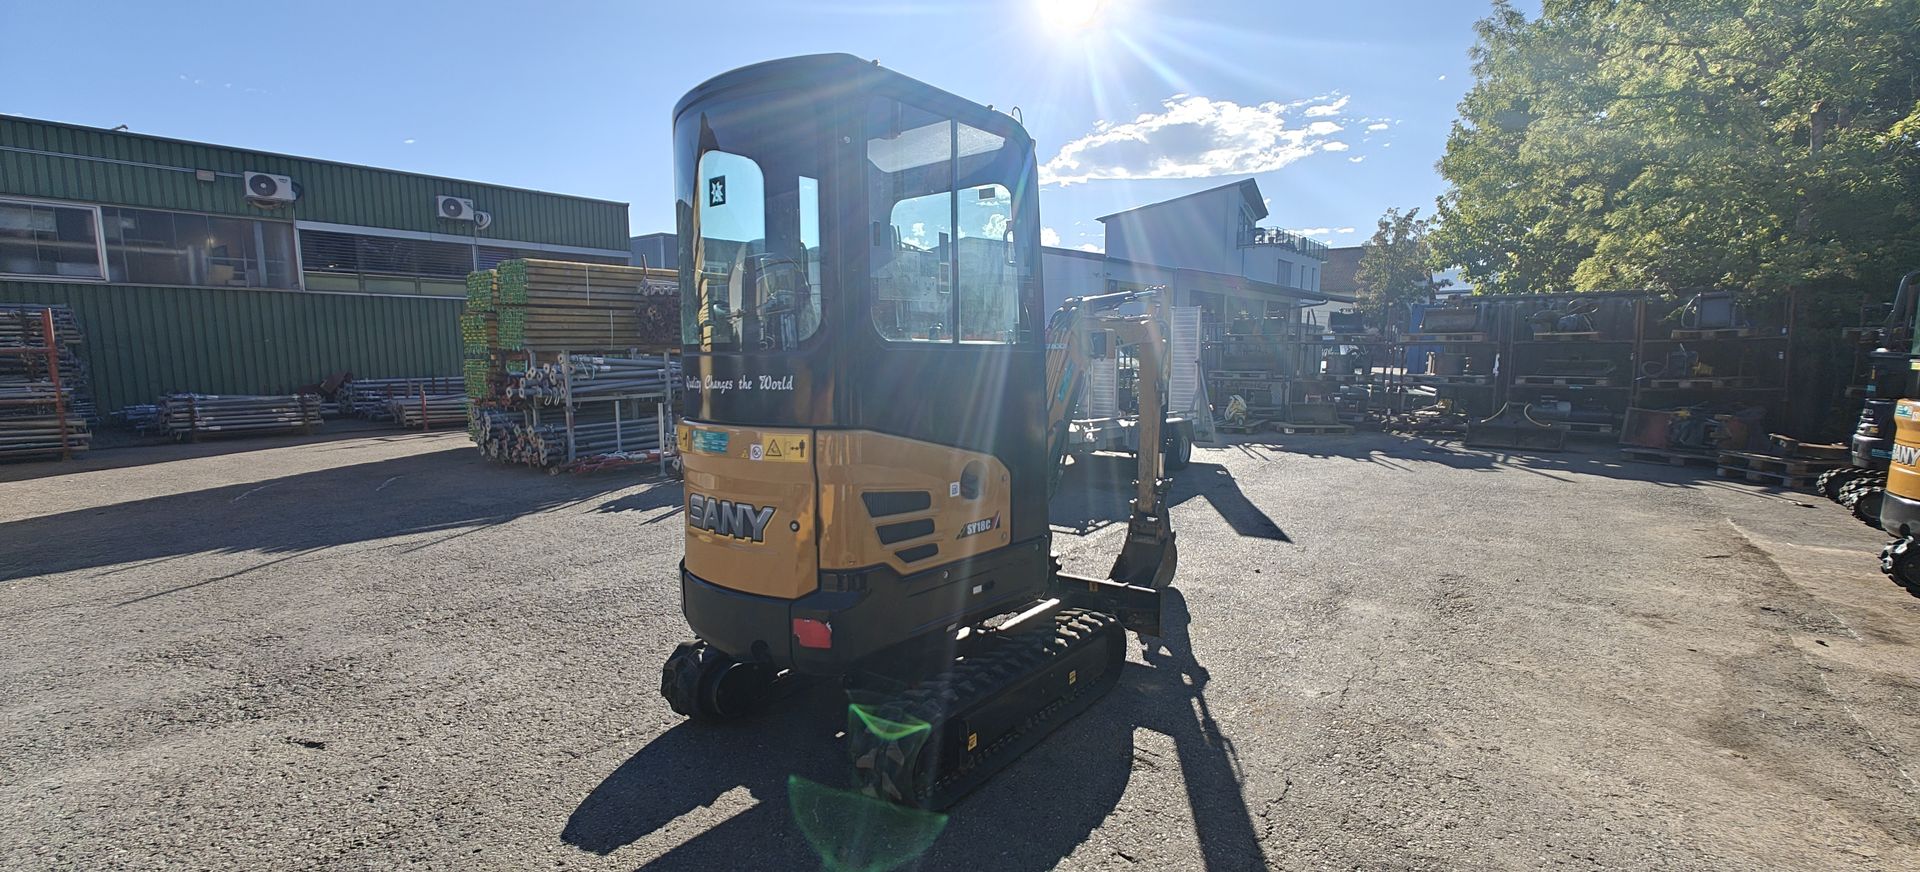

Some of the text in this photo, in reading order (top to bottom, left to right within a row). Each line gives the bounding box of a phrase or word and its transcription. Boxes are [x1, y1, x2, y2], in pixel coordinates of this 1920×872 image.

[704, 374, 734, 394] Changes
[738, 375, 753, 390] the
[759, 375, 794, 390] World
[690, 493, 776, 542] SANY
